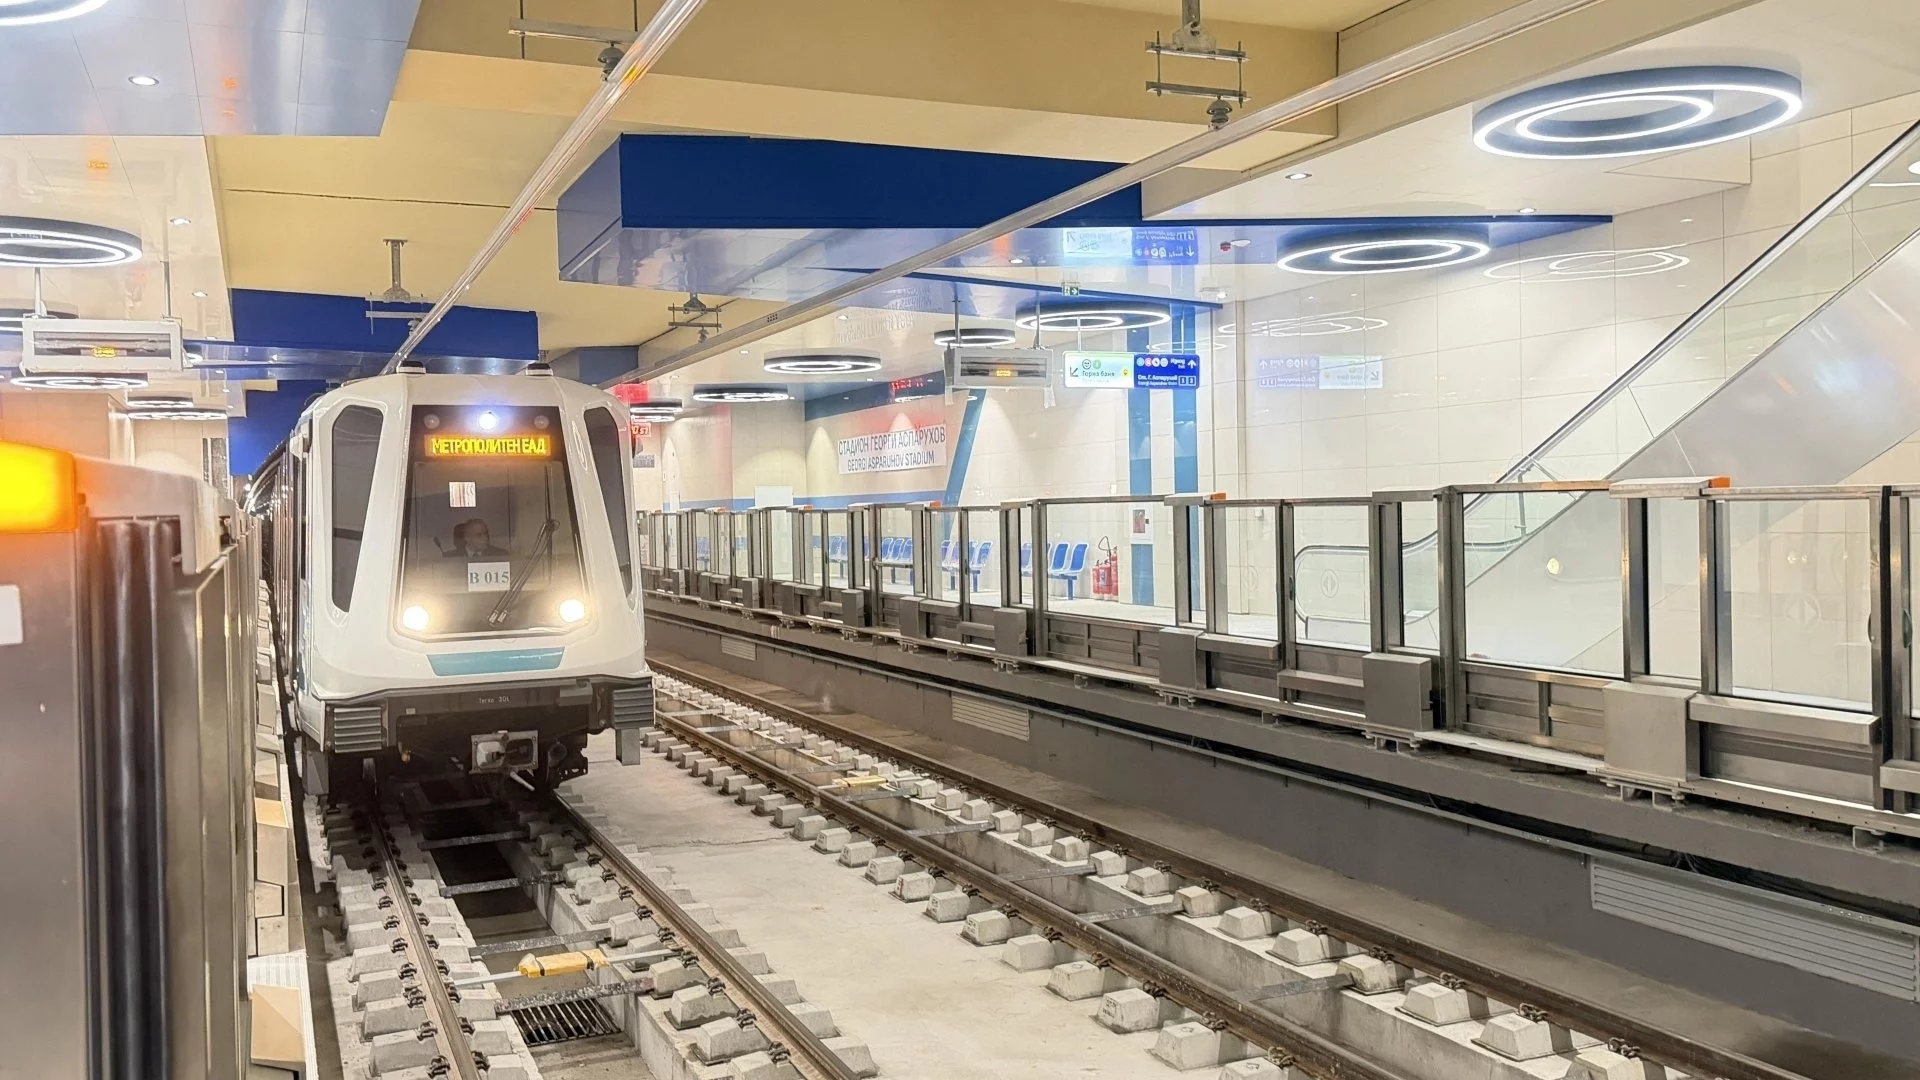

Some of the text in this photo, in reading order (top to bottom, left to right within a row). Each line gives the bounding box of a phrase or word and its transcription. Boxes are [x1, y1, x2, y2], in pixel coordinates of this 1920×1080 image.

[431, 437, 546, 455] МЕТРОПОЛИТЕН ЕАД
[838, 426, 946, 456] СТАДИОН ГЕОРГИ АСПАРУХОВ
[847, 450, 935, 472] GEORGI ASPARUHOV STADIUM
[484, 571, 510, 585] 015
